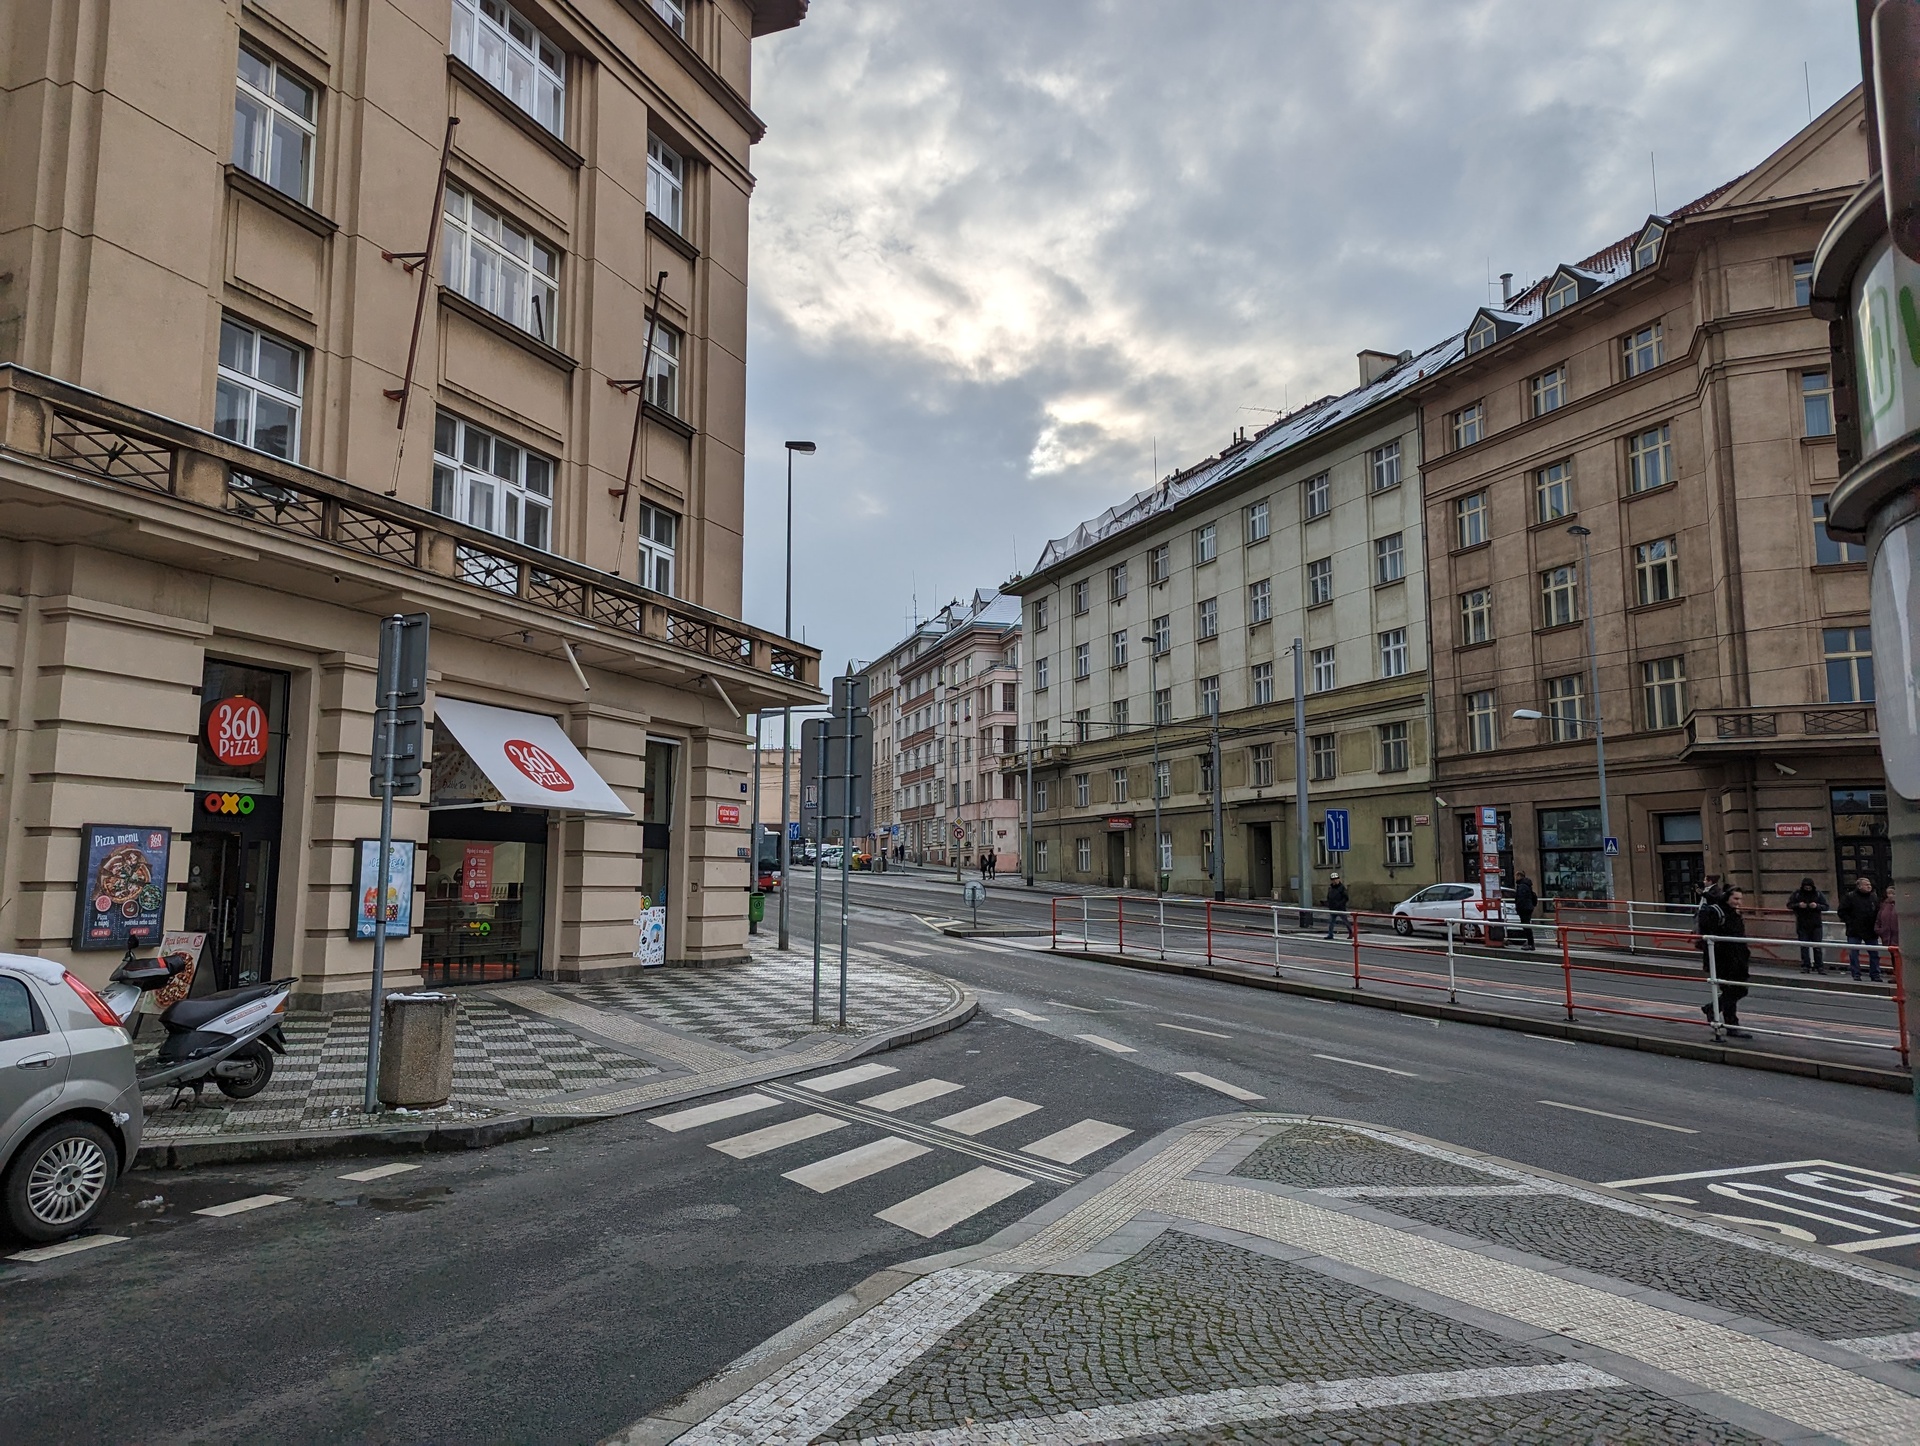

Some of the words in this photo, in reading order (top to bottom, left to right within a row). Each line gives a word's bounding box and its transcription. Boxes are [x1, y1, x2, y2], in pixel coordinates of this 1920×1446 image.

[219, 704, 261, 740] 360
[219, 738, 261, 757] Pizza
[508, 744, 556, 773] 360
[529, 771, 570, 786] Pizza
[94, 835, 115, 847] Pizza
[117, 832, 139, 844] menu
[150, 833, 162, 842] 360
